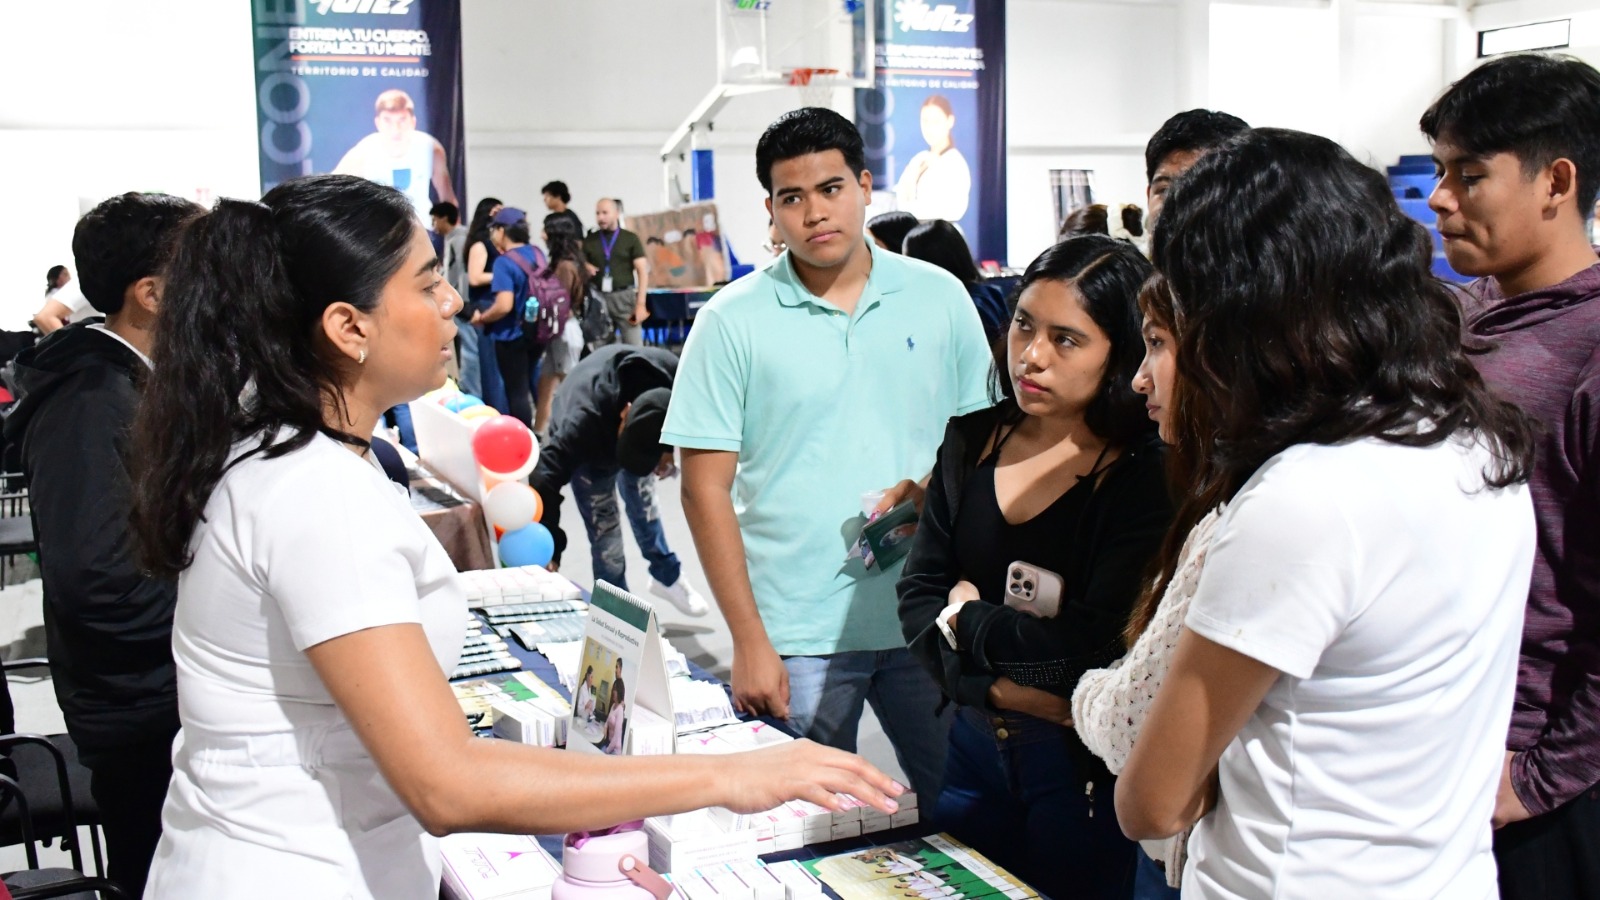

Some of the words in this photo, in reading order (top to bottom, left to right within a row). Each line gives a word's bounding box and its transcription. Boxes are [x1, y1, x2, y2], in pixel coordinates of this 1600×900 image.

[288, 27, 353, 41] ENTRENA
[353, 28, 372, 42] TU
[372, 28, 430, 43] CUERPO,
[289, 40, 367, 55] FORTALECE
[367, 42, 386, 55] TU
[386, 42, 432, 56] MENTE
[290, 66, 359, 77] TERRITORIO
[362, 67, 378, 77] DE
[380, 67, 430, 78] CALIDAD
[928, 79, 941, 89] DE
